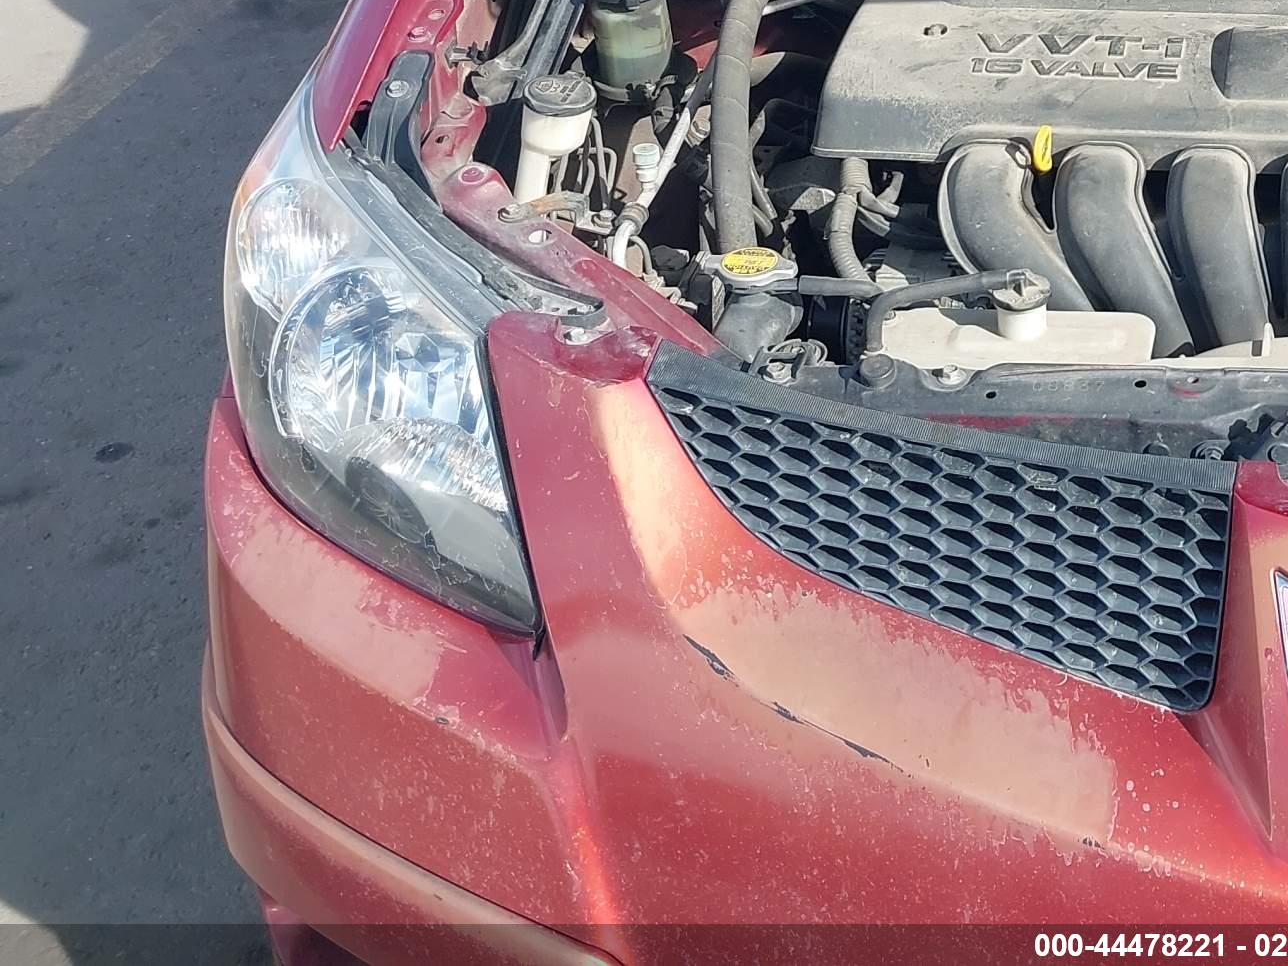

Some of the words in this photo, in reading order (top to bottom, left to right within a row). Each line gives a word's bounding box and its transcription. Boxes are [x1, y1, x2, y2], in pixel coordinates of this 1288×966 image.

[977, 32, 1185, 59] VVT-i
[970, 57, 1024, 75] 16
[1029, 58, 1180, 80] VALVE
